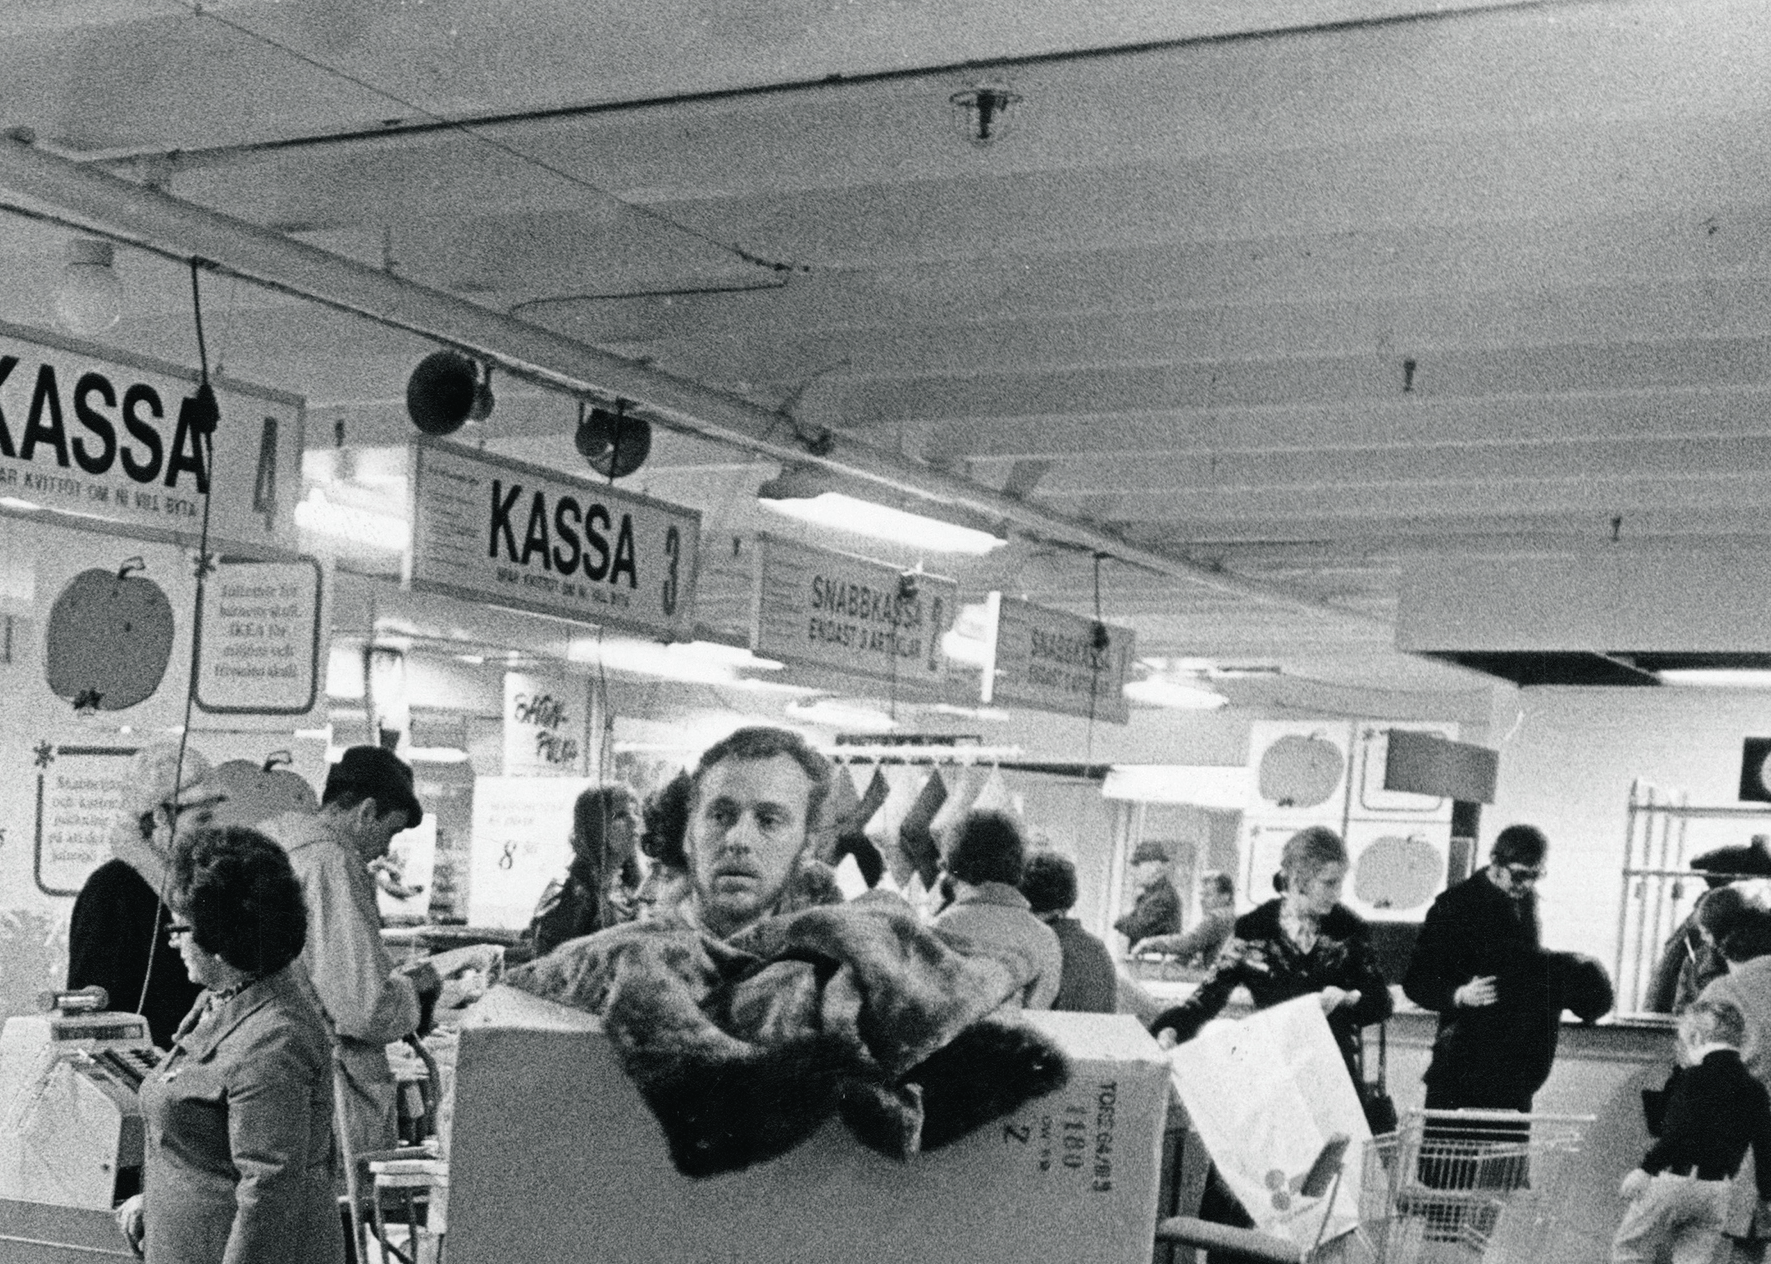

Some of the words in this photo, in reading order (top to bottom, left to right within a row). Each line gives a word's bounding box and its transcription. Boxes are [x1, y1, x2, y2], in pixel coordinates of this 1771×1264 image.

[24, 472, 82, 498] KVITTOT
[87, 485, 109, 502] OM
[115, 489, 130, 506] NI
[135, 491, 159, 512] VILL
[165, 498, 197, 518] BYTA
[489, 479, 638, 590] KASSA
[661, 524, 681, 616] 3
[812, 574, 922, 630] SNABBKASSA
[809, 617, 857, 647] ENDAST
